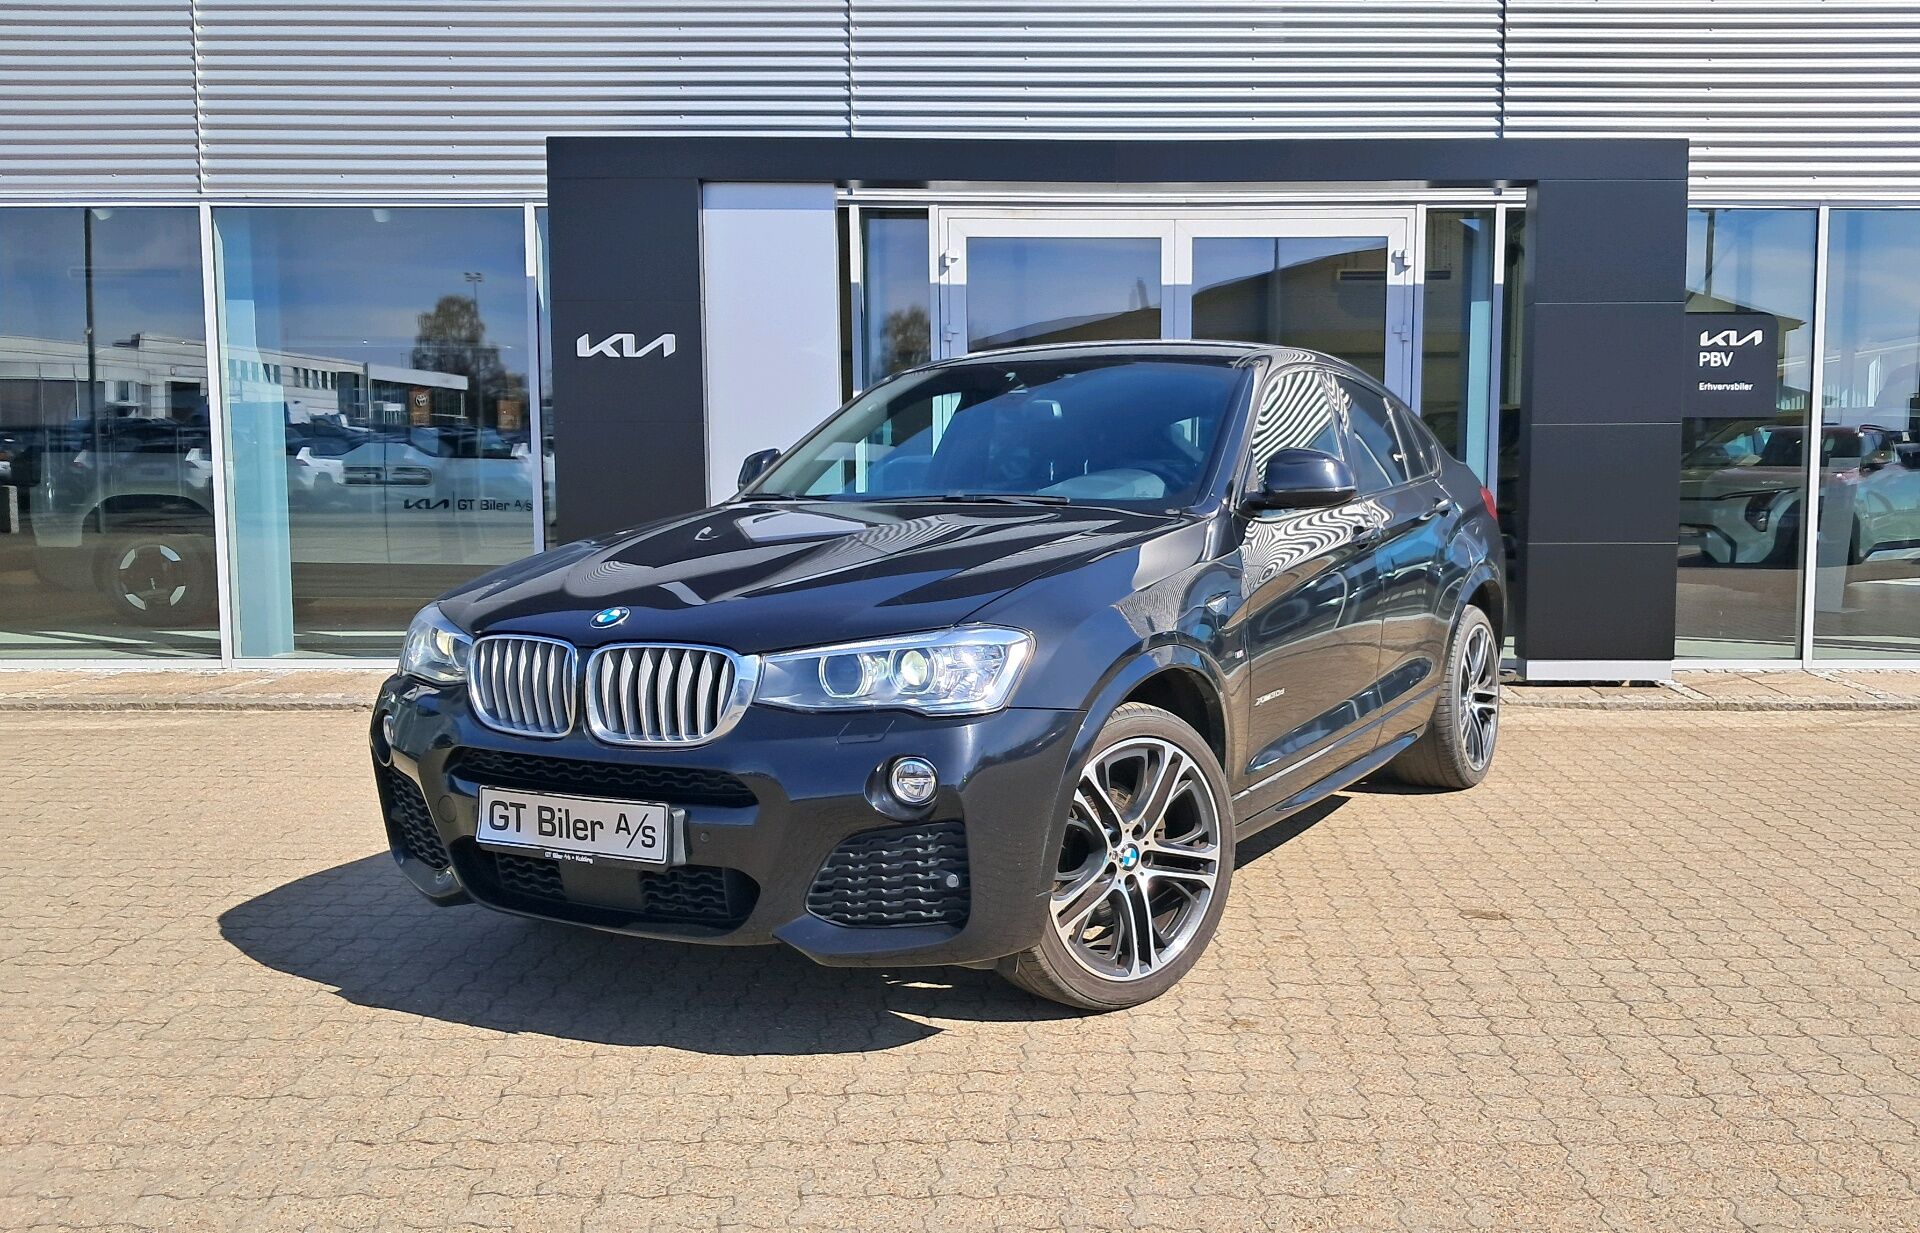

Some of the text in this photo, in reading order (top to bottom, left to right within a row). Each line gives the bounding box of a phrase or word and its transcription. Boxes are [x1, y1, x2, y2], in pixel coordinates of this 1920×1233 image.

[576, 333, 676, 358] KIA
[1700, 330, 1763, 347] KIA
[1699, 351, 1734, 367] PBV
[1699, 382, 1753, 391] Erhvervsbiler
[457, 499, 475, 511] GT
[480, 499, 510, 511] Biler
[489, 800, 656, 849] GT Biler A/S
